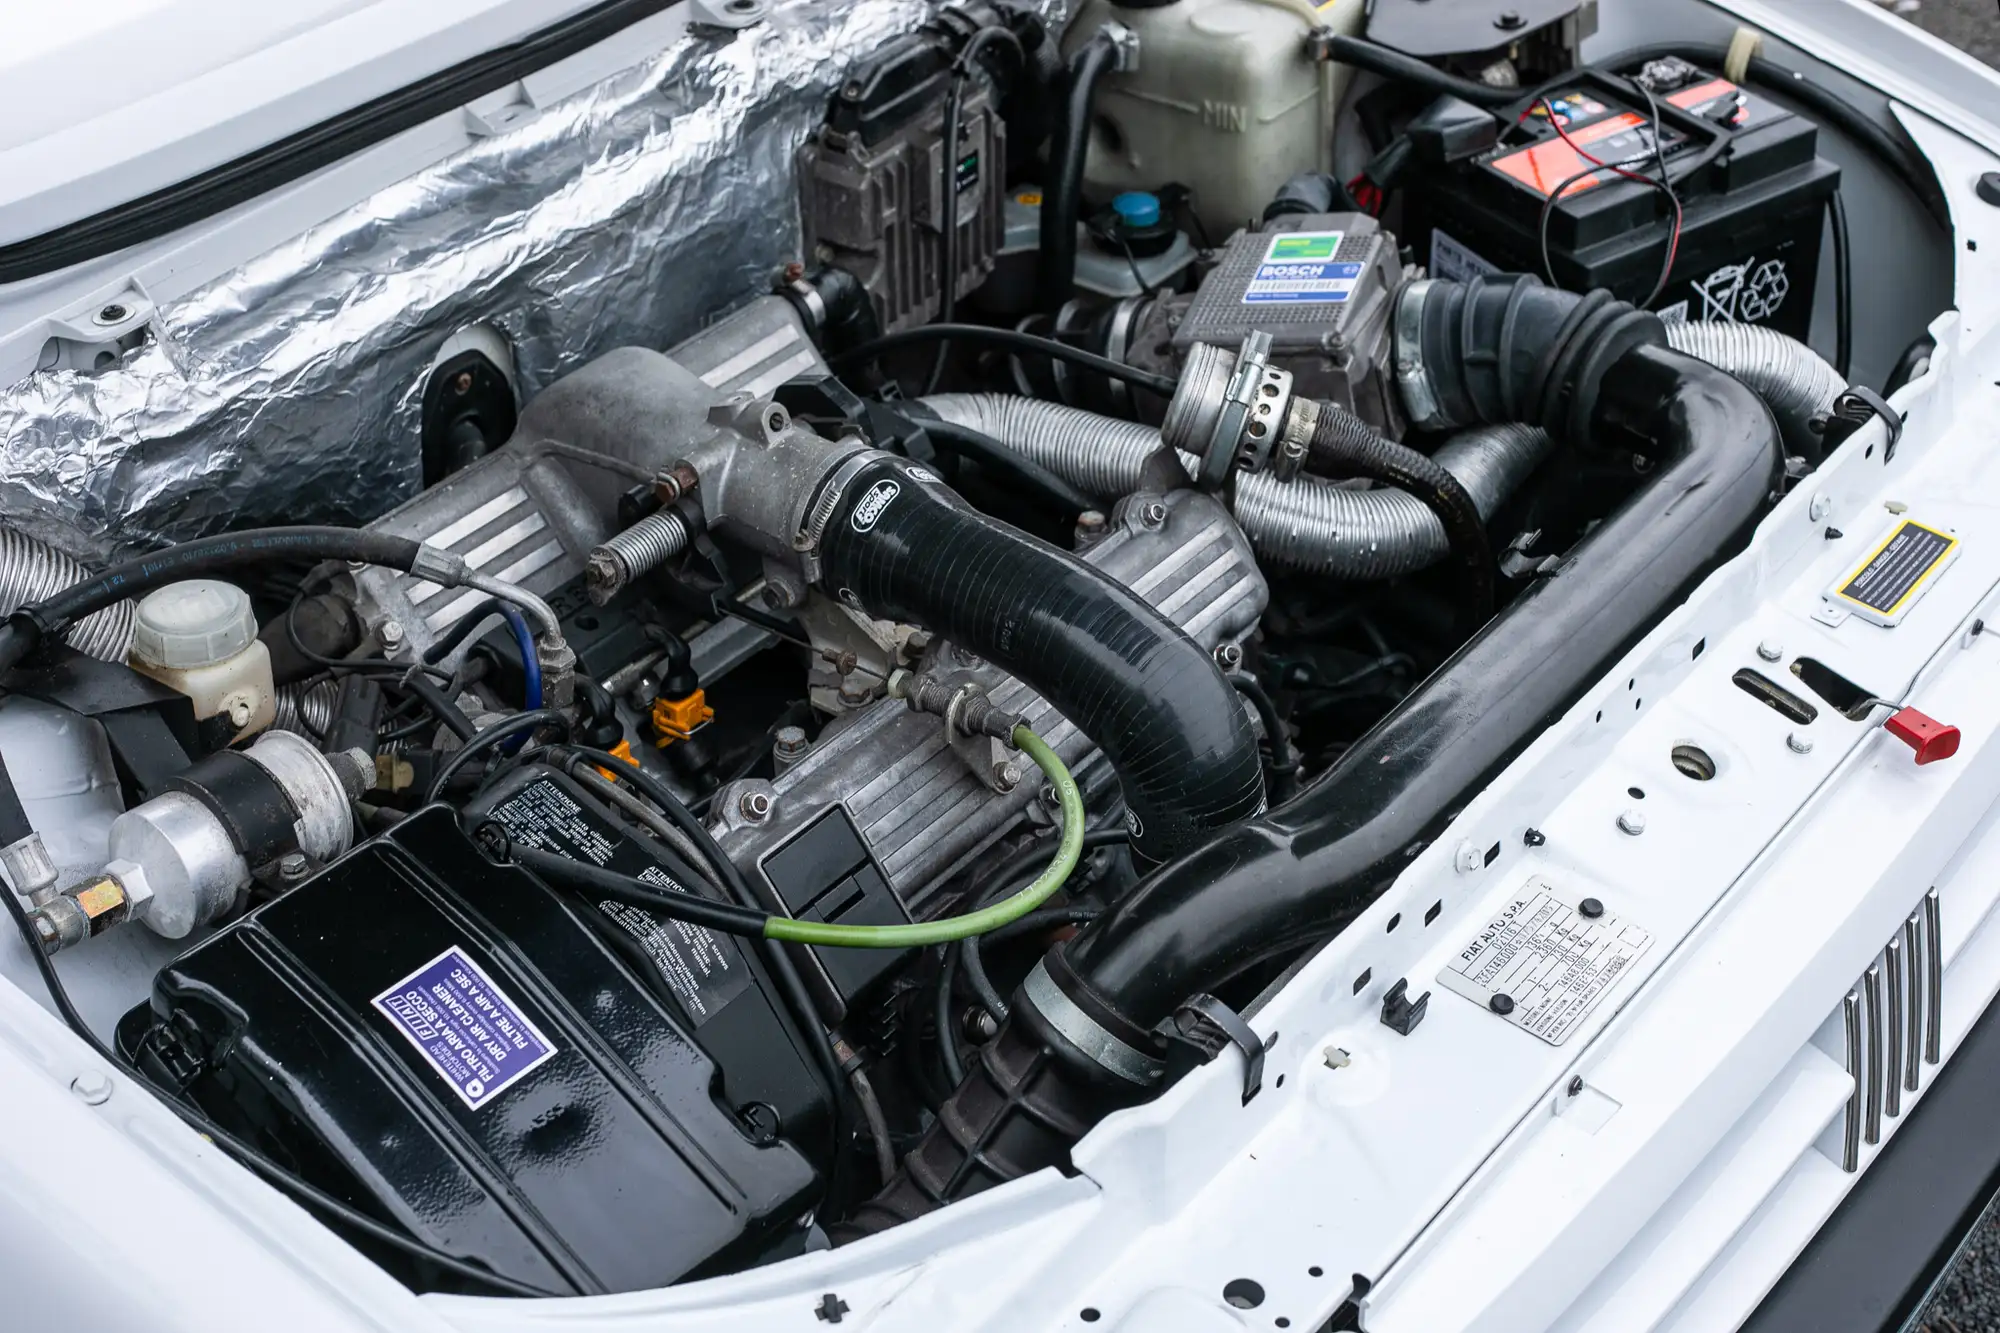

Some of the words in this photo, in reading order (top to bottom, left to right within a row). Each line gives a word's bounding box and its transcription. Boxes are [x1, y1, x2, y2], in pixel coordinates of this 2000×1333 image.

[1204, 99, 1247, 132] MIN
[1262, 265, 1324, 276] BOSCH
[858, 490, 880, 516] sport
[864, 486, 896, 523] SAMCO
[541, 780, 581, 812] ATTENZIONE
[510, 799, 549, 829] ATTENTION
[589, 830, 613, 848] cilindri
[669, 918, 691, 944] orkshop
[1461, 940, 1483, 961] FIAT
[1480, 919, 1505, 943] AUTO
[1502, 900, 1526, 919] S.P.A.
[1534, 938, 1556, 958] 2360
[1554, 927, 1570, 938] Kg
[712, 944, 728, 970] screws
[1549, 944, 1568, 960] 730
[1566, 933, 1581, 944] Kg
[1577, 939, 1592, 950] Kg
[450, 968, 472, 988] SEC
[468, 985, 480, 995] A
[406, 990, 438, 1022] SECCO
[432, 983, 473, 1025] CLEANER
[474, 993, 494, 1011] AIR
[489, 1008, 501, 1018] A
[391, 995, 432, 1039] FIAT
[434, 1018, 446, 1028] A
[441, 1026, 466, 1050] ARIA
[469, 1023, 490, 1041] AIR
[495, 1016, 528, 1049] FILTRE
[429, 1045, 464, 1082] WHITEHEAD
[436, 1041, 470, 1077] MOTOFIDES
[483, 1040, 507, 1061] DRY
[460, 1048, 494, 1082] FILTRO
